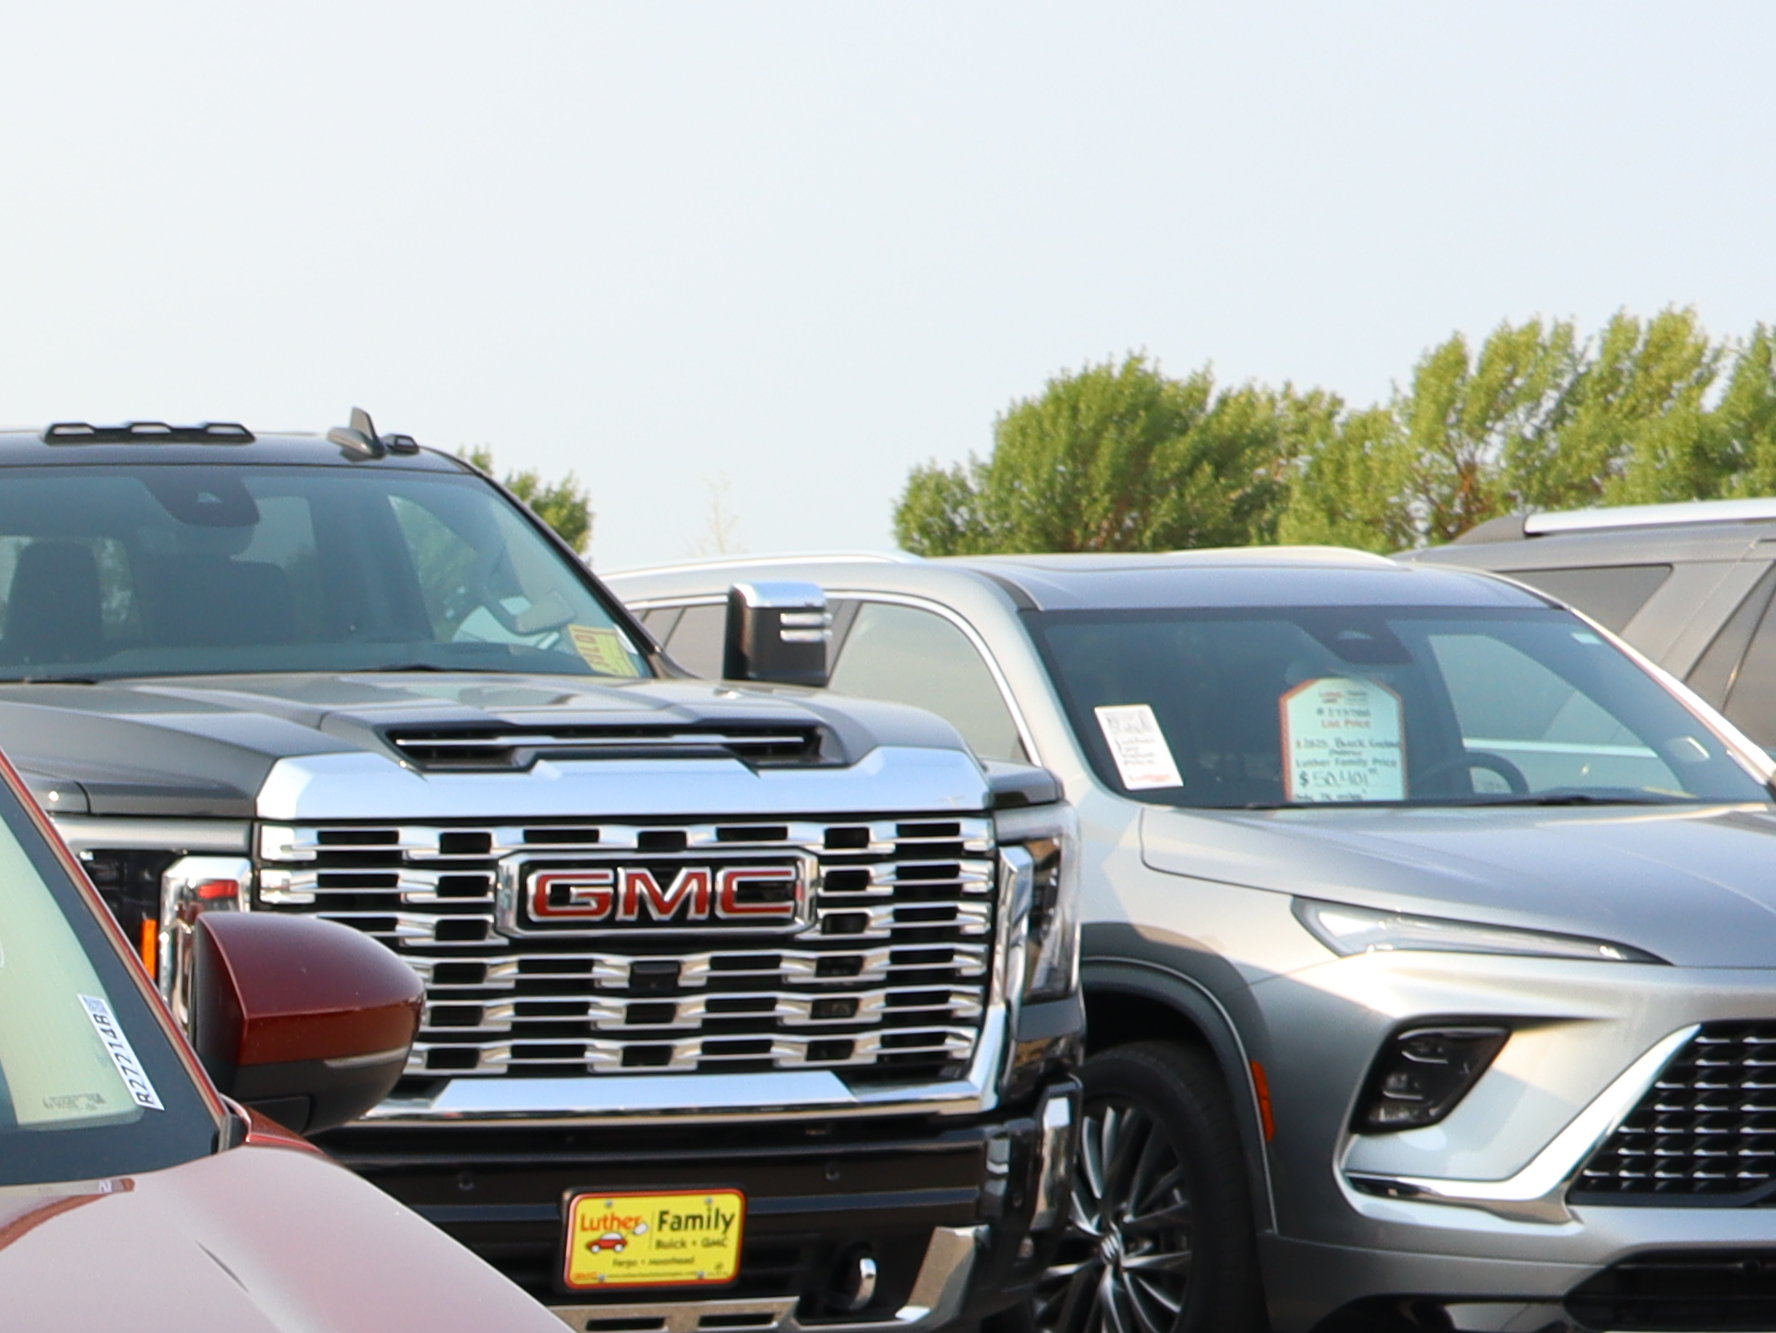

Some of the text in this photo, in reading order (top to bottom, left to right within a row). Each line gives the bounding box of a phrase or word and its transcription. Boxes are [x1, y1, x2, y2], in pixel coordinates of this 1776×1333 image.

[526, 865, 797, 922] GMC
[580, 1203, 735, 1235] Luther Family
